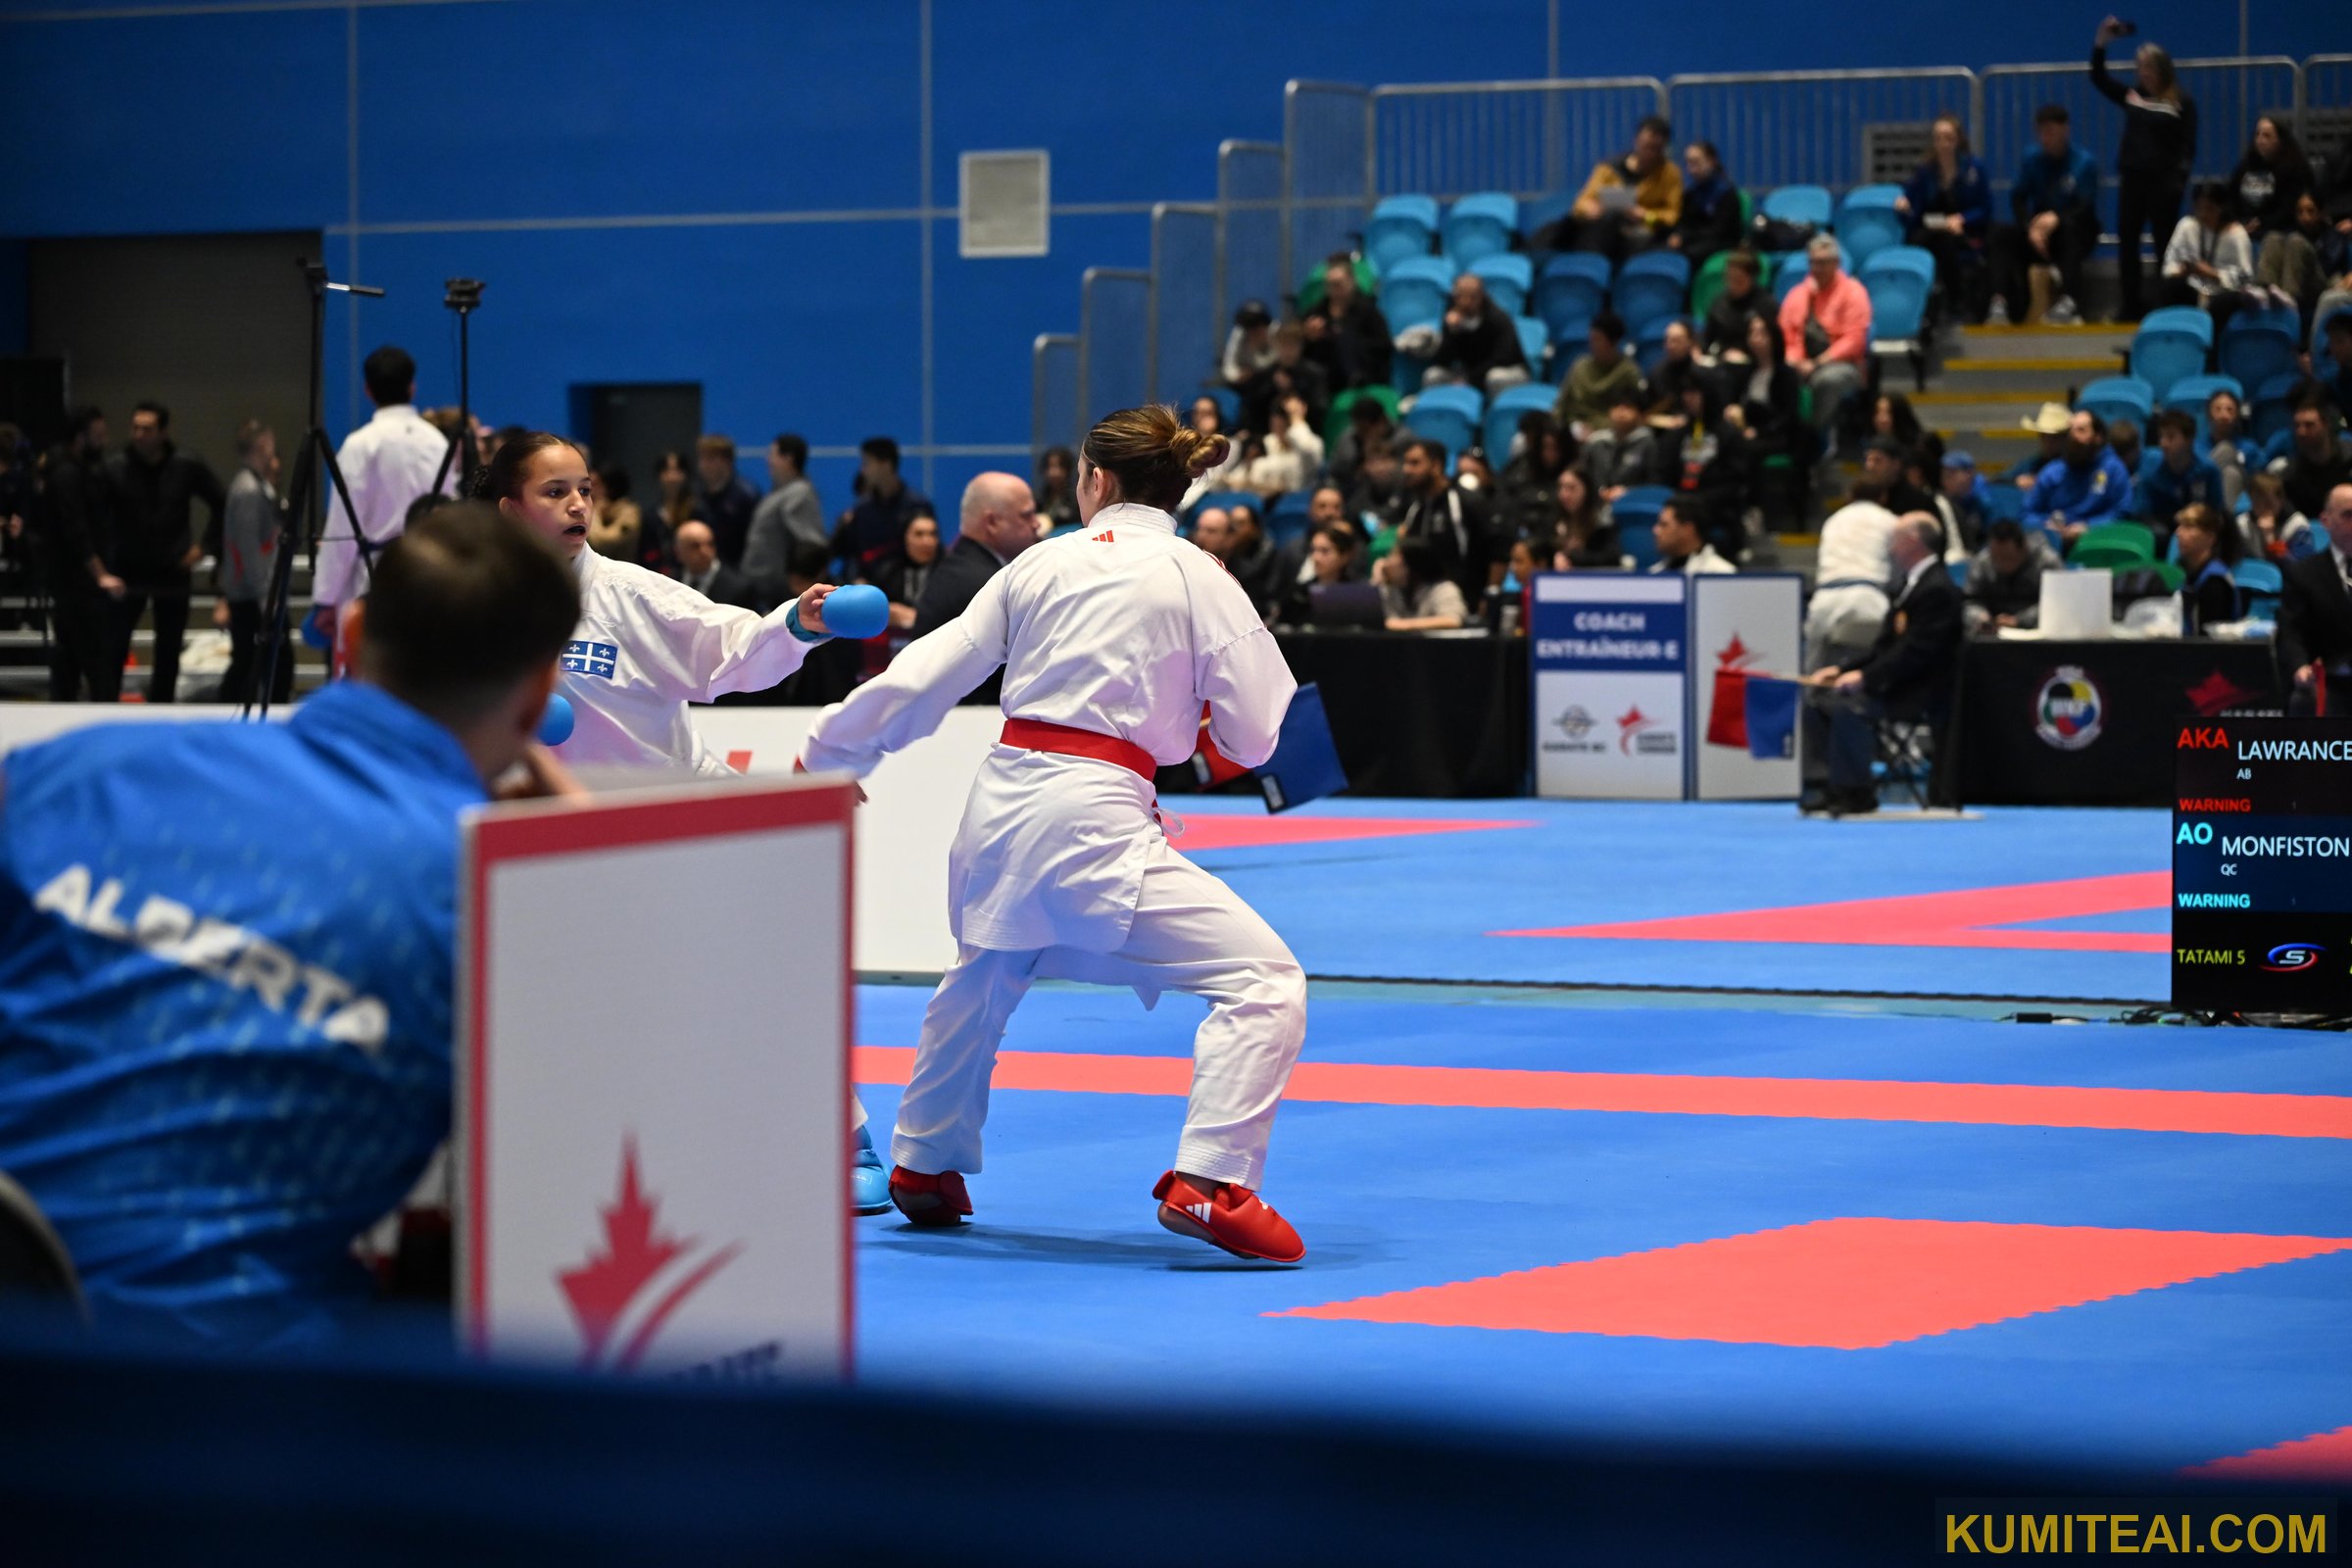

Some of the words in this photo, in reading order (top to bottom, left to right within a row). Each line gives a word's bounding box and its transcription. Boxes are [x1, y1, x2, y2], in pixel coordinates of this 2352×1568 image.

[1573, 612, 1646, 632] COACH
[2177, 727, 2230, 749] AKA
[2237, 740, 2352, 761] LAWRANCE
[2236, 767, 2252, 780] AB
[2179, 798, 2251, 812] WARNING
[2176, 821, 2214, 846] AO
[2222, 835, 2350, 858] MONFISTON
[2220, 862, 2237, 877] QC
[2178, 893, 2251, 909] WARNING
[2177, 949, 2232, 964] TATAMI
[2237, 950, 2245, 964] 5
